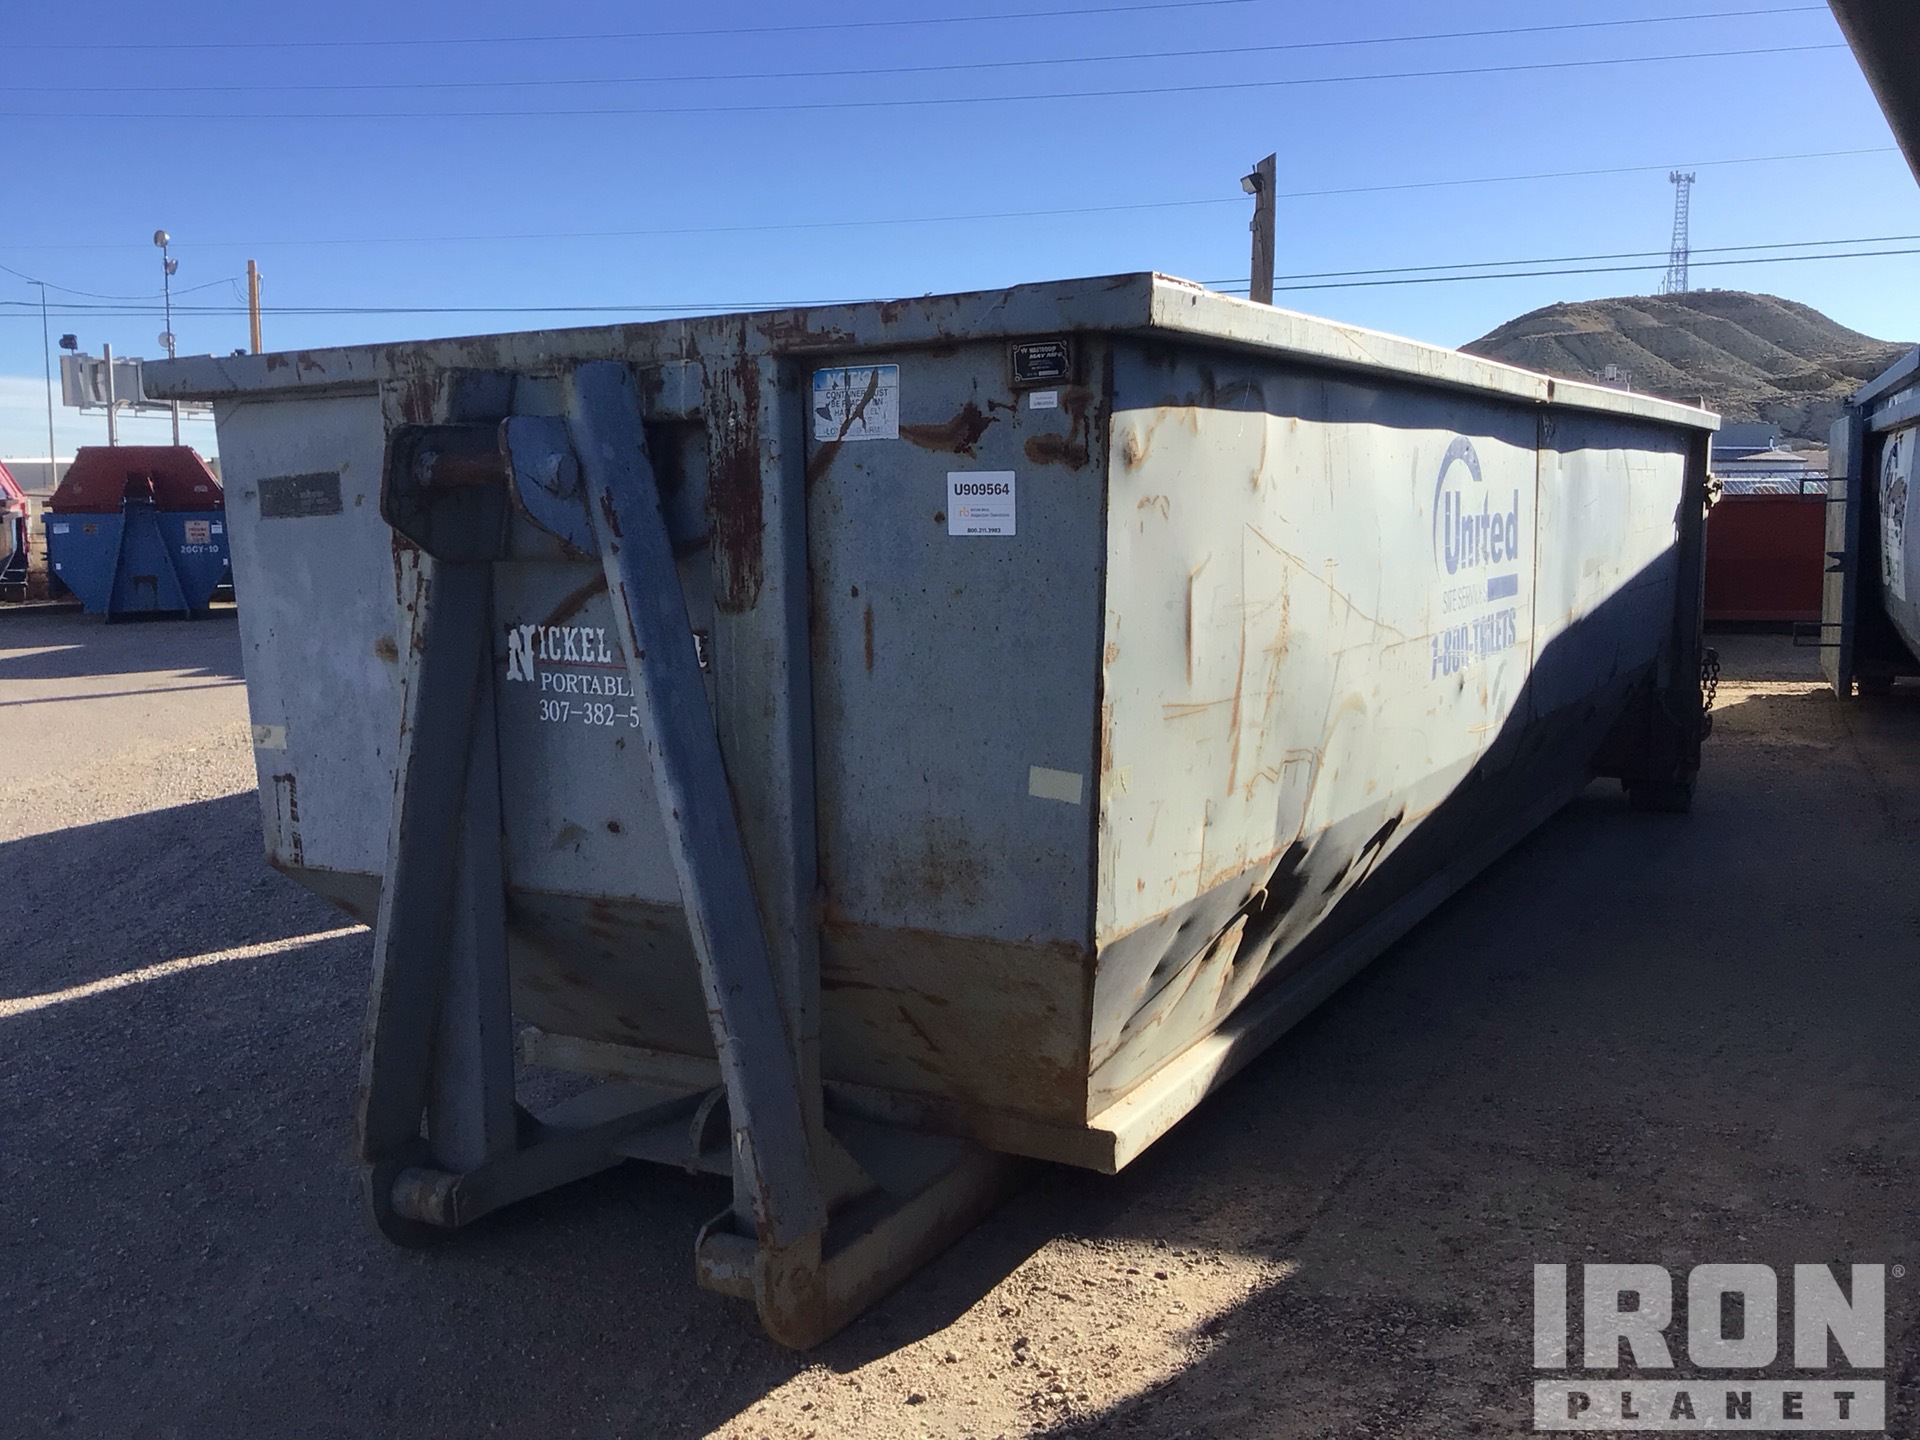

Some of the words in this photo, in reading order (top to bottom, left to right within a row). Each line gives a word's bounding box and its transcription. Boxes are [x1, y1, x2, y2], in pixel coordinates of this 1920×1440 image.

[954, 483, 1010, 496] U909564
[181, 545, 219, 553] 20CY-10
[1445, 488, 1518, 575] United
[507, 624, 612, 682] NICKEL
